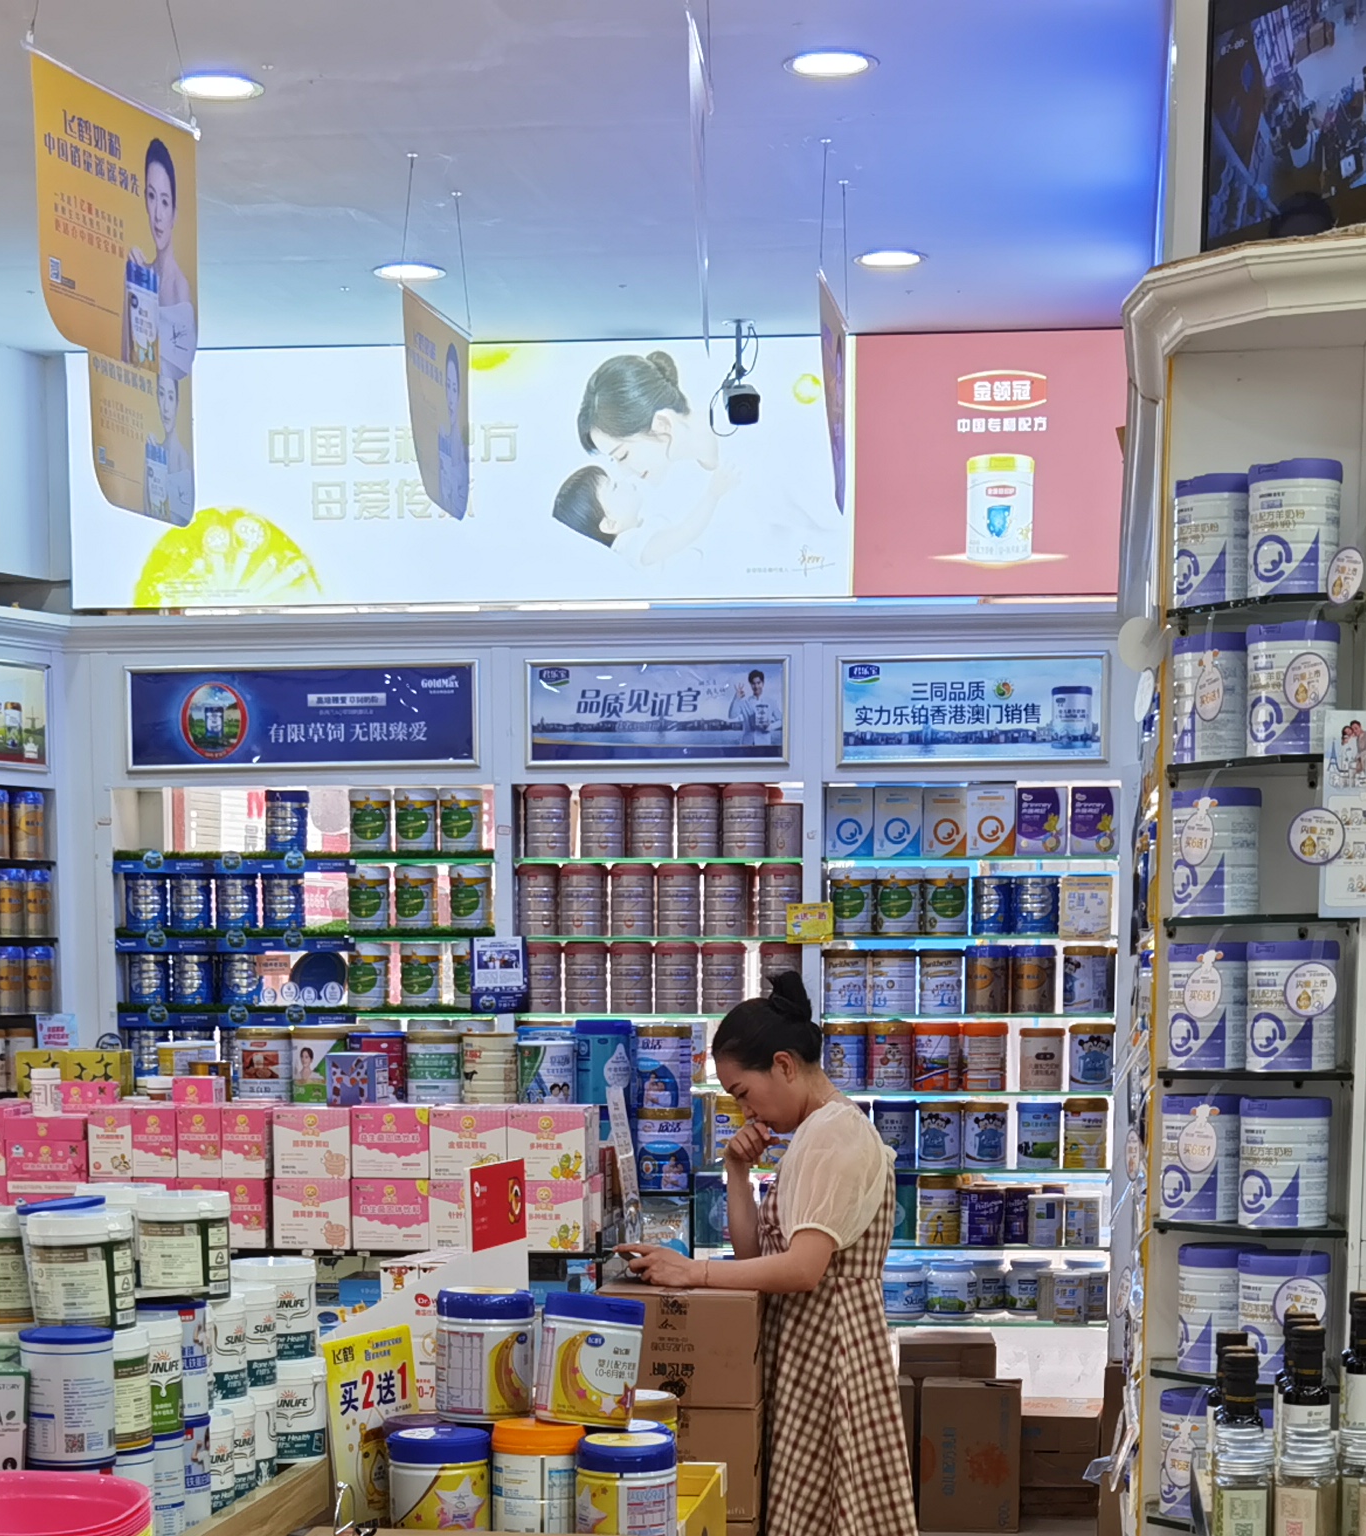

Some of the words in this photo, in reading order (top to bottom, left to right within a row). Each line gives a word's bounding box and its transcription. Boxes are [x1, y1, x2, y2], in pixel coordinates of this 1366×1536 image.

[973, 380, 1031, 401] 金领冠
[957, 417, 1047, 432] 中国专利配方
[852, 664, 880, 678] 君乐宝
[911, 681, 985, 701] 三同品质
[576, 687, 699, 718] 品质见证官
[855, 703, 1042, 727] 实力乐铂香港澳门销售
[268, 722, 346, 744] 有限草饲
[349, 720, 428, 742] 无限臻爱
[277, 1298, 305, 1309] UNLIFE
[332, 1344, 354, 1365] 飞鹤
[340, 1363, 408, 1416] 买2送1
